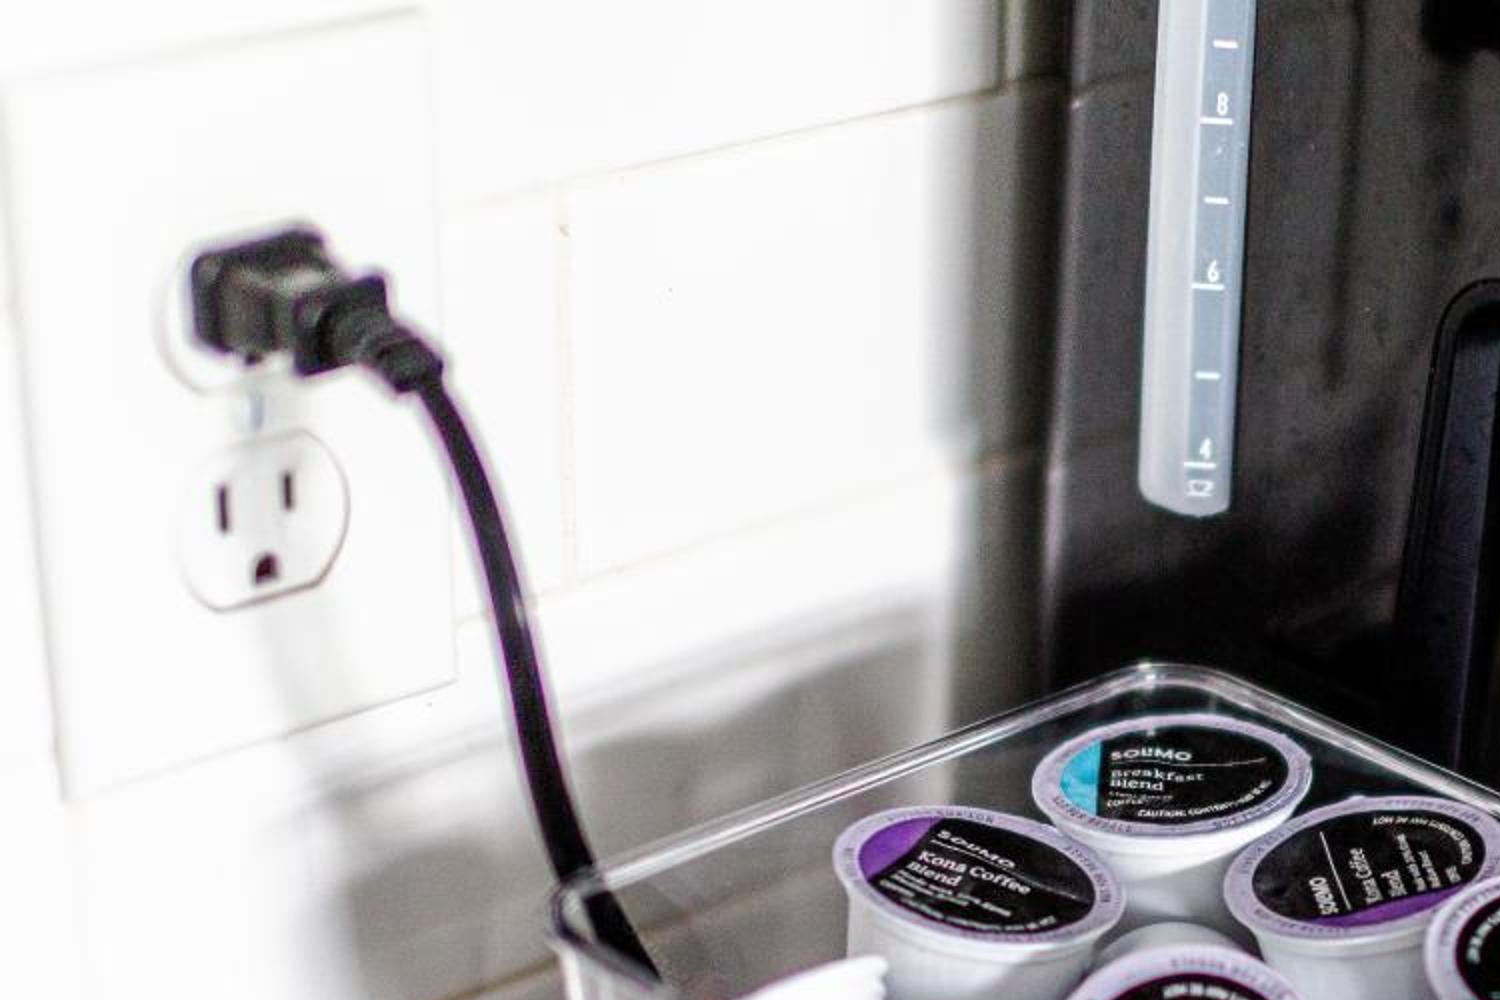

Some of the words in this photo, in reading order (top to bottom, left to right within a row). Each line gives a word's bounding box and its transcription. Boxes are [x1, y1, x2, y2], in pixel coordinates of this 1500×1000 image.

[1217, 92, 1229, 116] 8
[1207, 260, 1220, 283] 6
[1199, 438, 1213, 460] 4
[1109, 778, 1164, 791] Blend
[1110, 767, 1207, 783] Breakfast
[906, 861, 962, 887] Blend
[917, 850, 967, 874] Kona
[969, 865, 1031, 895] Coffee
